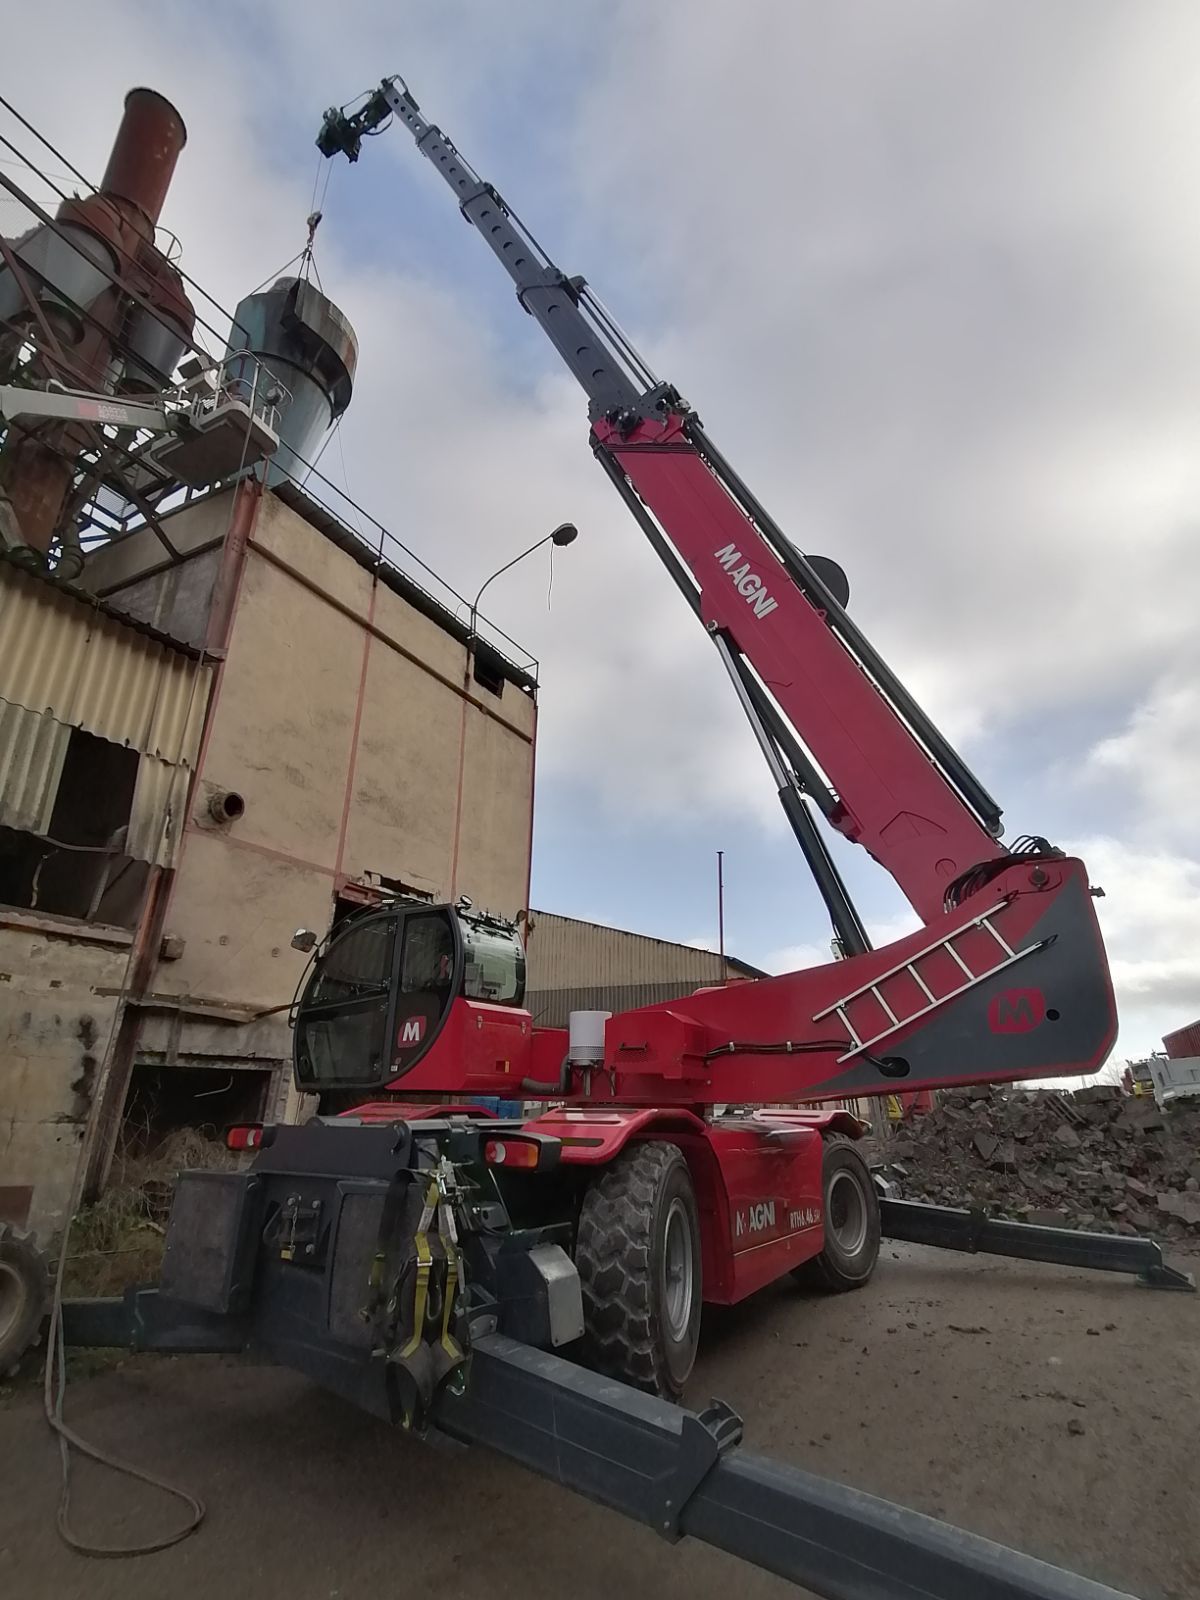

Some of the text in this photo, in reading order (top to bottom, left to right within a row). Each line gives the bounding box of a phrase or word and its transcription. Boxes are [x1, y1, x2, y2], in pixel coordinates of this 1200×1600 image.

[714, 543, 779, 620] MAGNI
[998, 997, 1035, 1025] M
[402, 1021, 420, 1042] M
